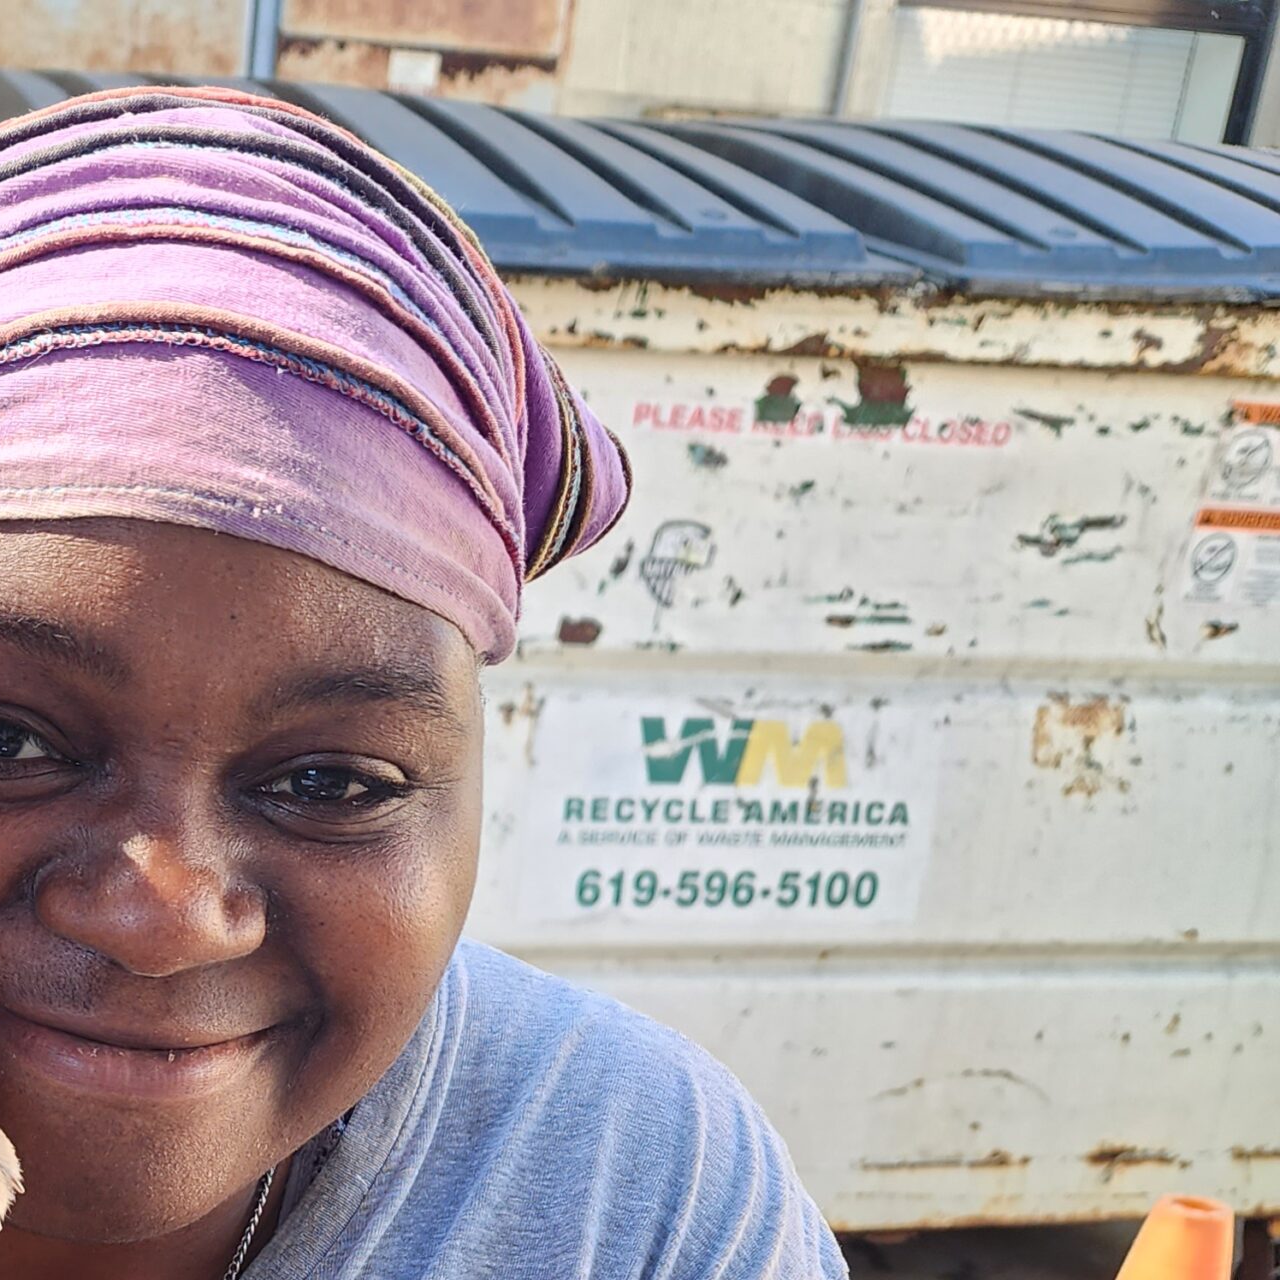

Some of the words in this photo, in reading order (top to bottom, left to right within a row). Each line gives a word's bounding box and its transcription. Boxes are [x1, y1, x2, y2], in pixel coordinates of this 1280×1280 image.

[632, 404, 743, 433] PLEASE
[901, 416, 1014, 448] CLOSED
[640, 717, 848, 789] WM
[563, 797, 730, 823] RECYCLE
[740, 798, 910, 827] AMERICA
